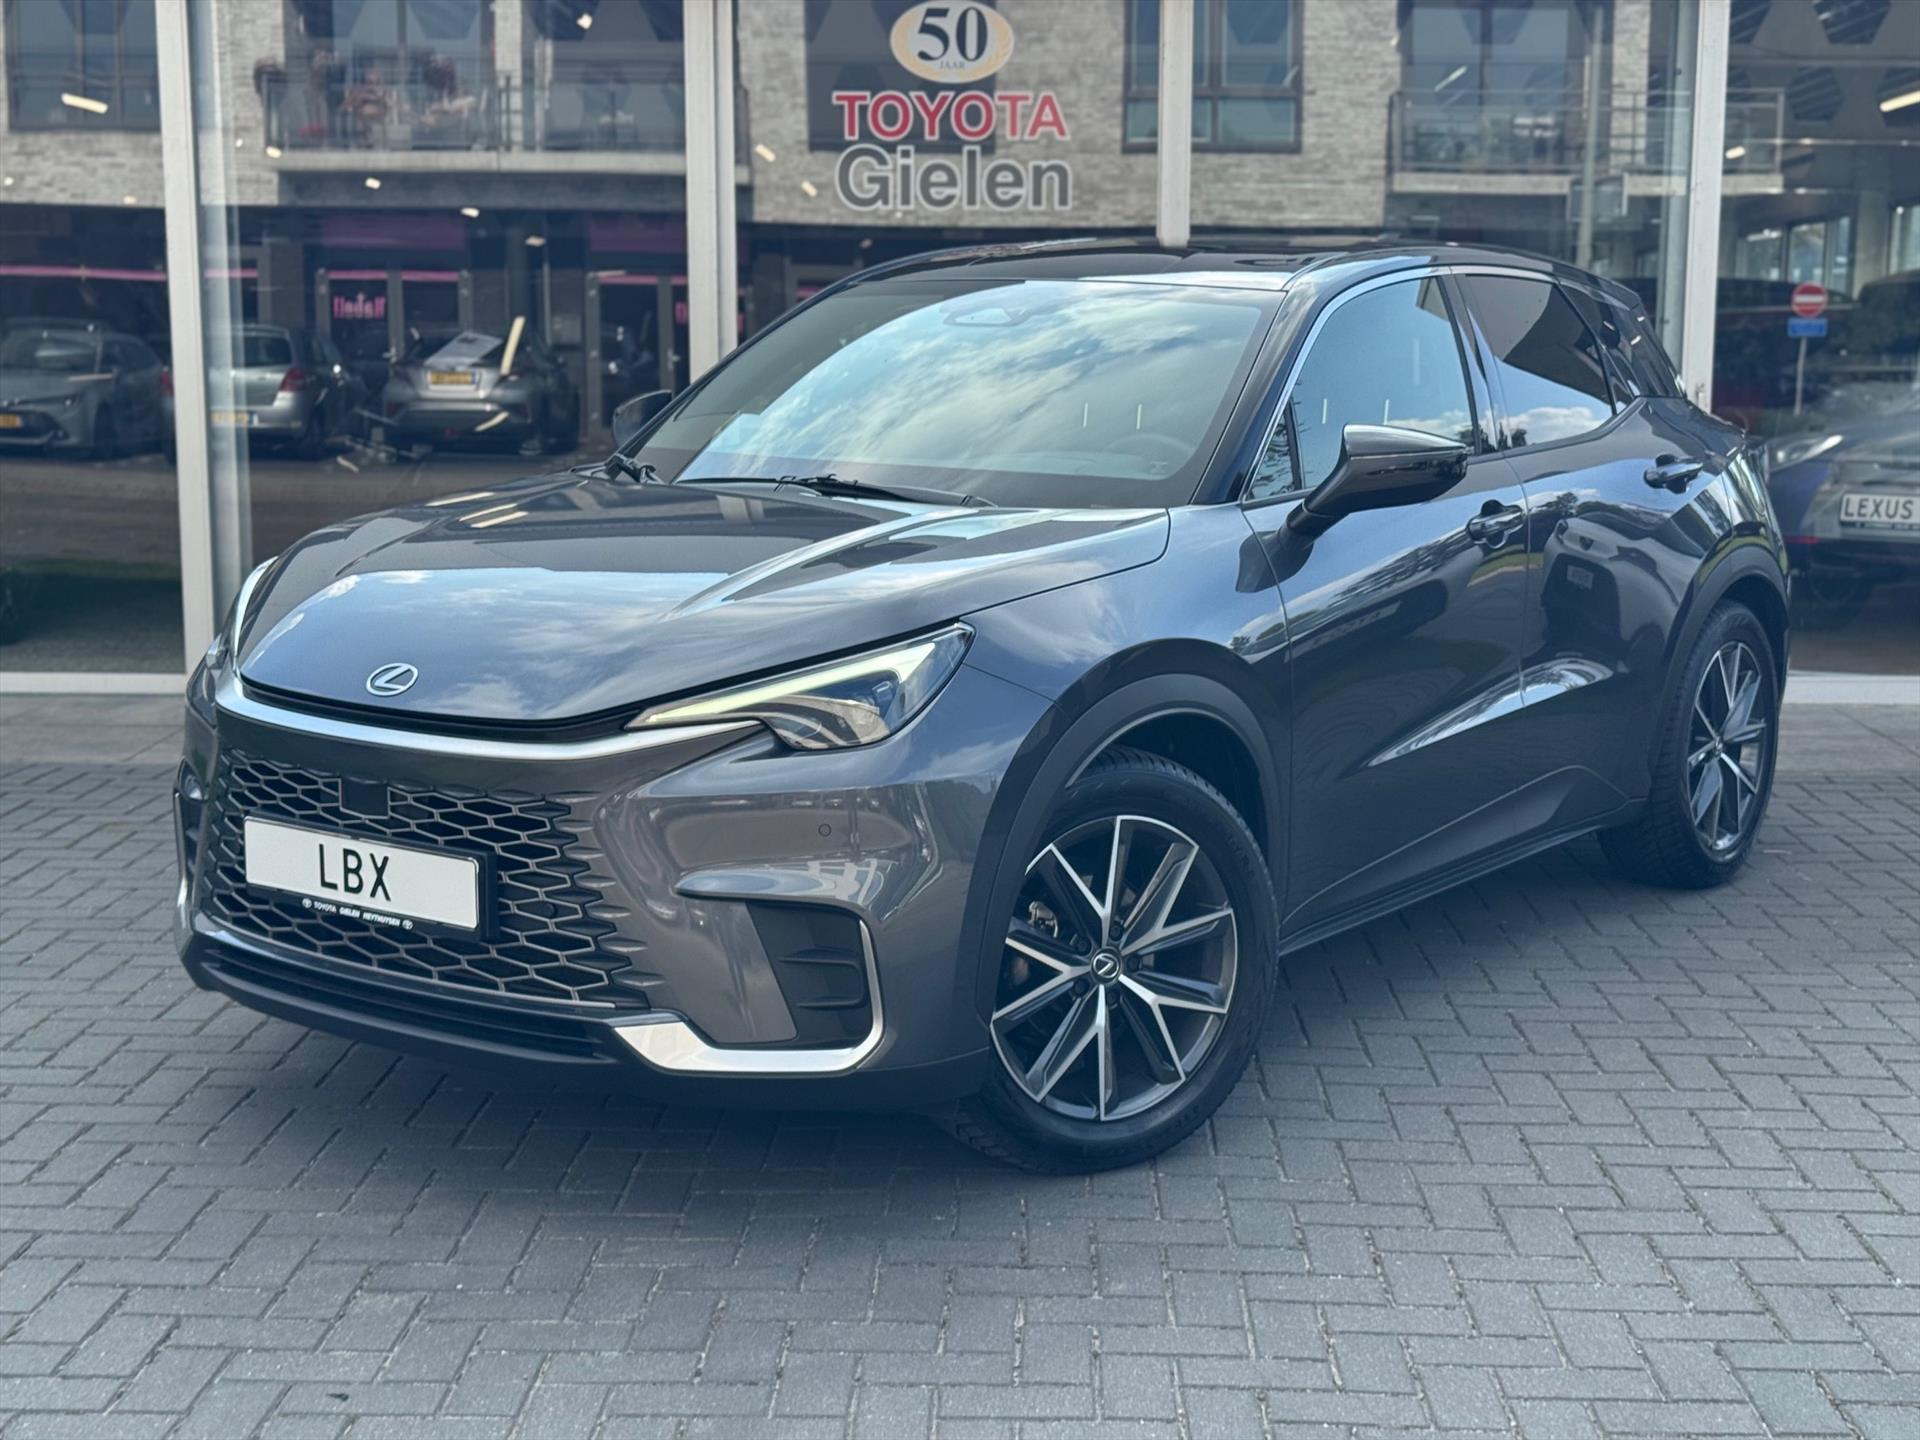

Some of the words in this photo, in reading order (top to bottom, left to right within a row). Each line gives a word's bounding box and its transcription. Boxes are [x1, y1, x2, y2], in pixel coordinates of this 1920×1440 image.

[917, 7, 988, 62] 50
[939, 61, 966, 70] JAAR
[833, 91, 1070, 141] TOYOTA
[836, 144, 1073, 211] Gielen
[1844, 497, 1914, 520] LEXUS
[319, 844, 391, 901] LBX
[314, 902, 336, 913] TOYOTA
